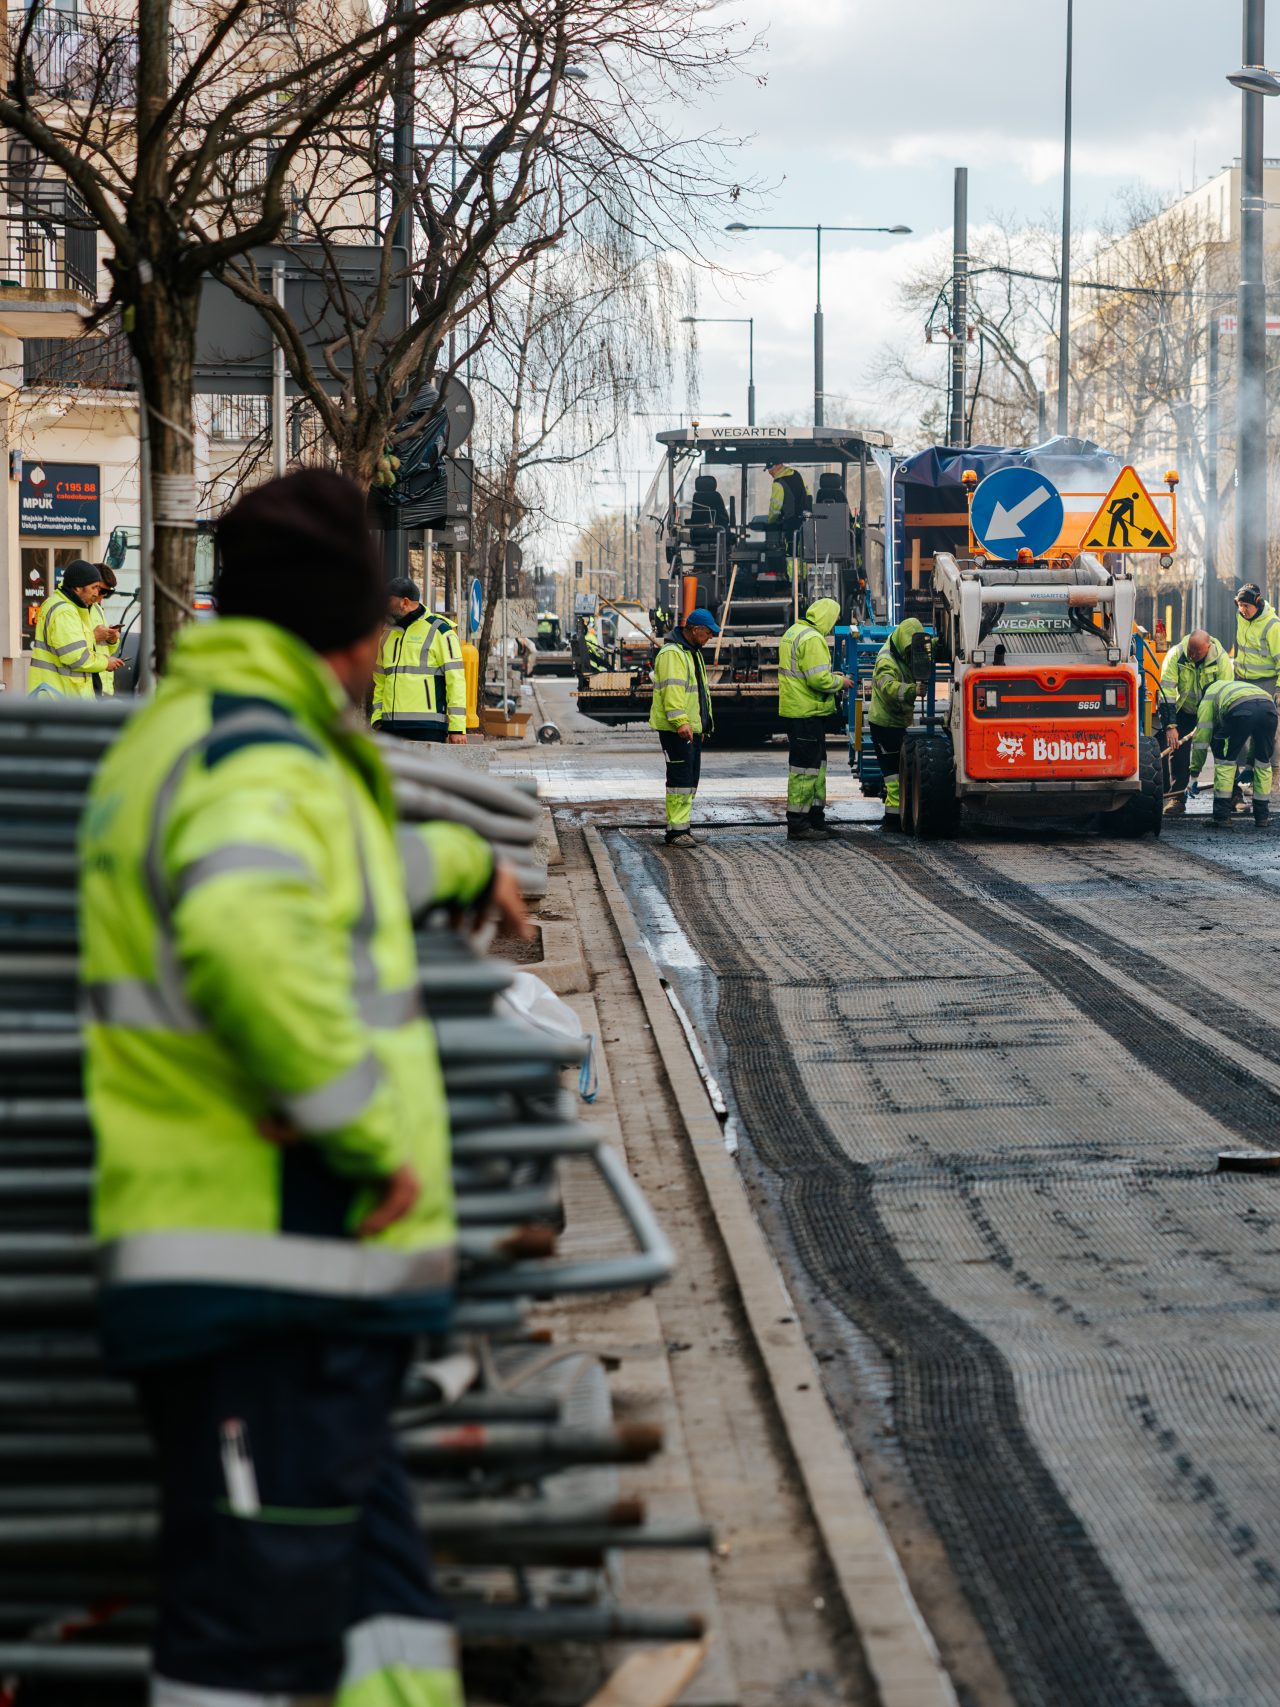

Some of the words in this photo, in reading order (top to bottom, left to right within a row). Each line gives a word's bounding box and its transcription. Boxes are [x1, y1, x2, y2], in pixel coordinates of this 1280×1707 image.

[712, 428, 787, 437] WEGARTEN
[65, 483, 82, 492] 195
[84, 483, 96, 492] 88
[23, 497, 53, 509] MPUK
[25, 588, 45, 597] MPUK
[997, 620, 1072, 629] WEGARTEN
[1078, 701, 1101, 710] S650
[1033, 737, 1107, 761] Bobcat
